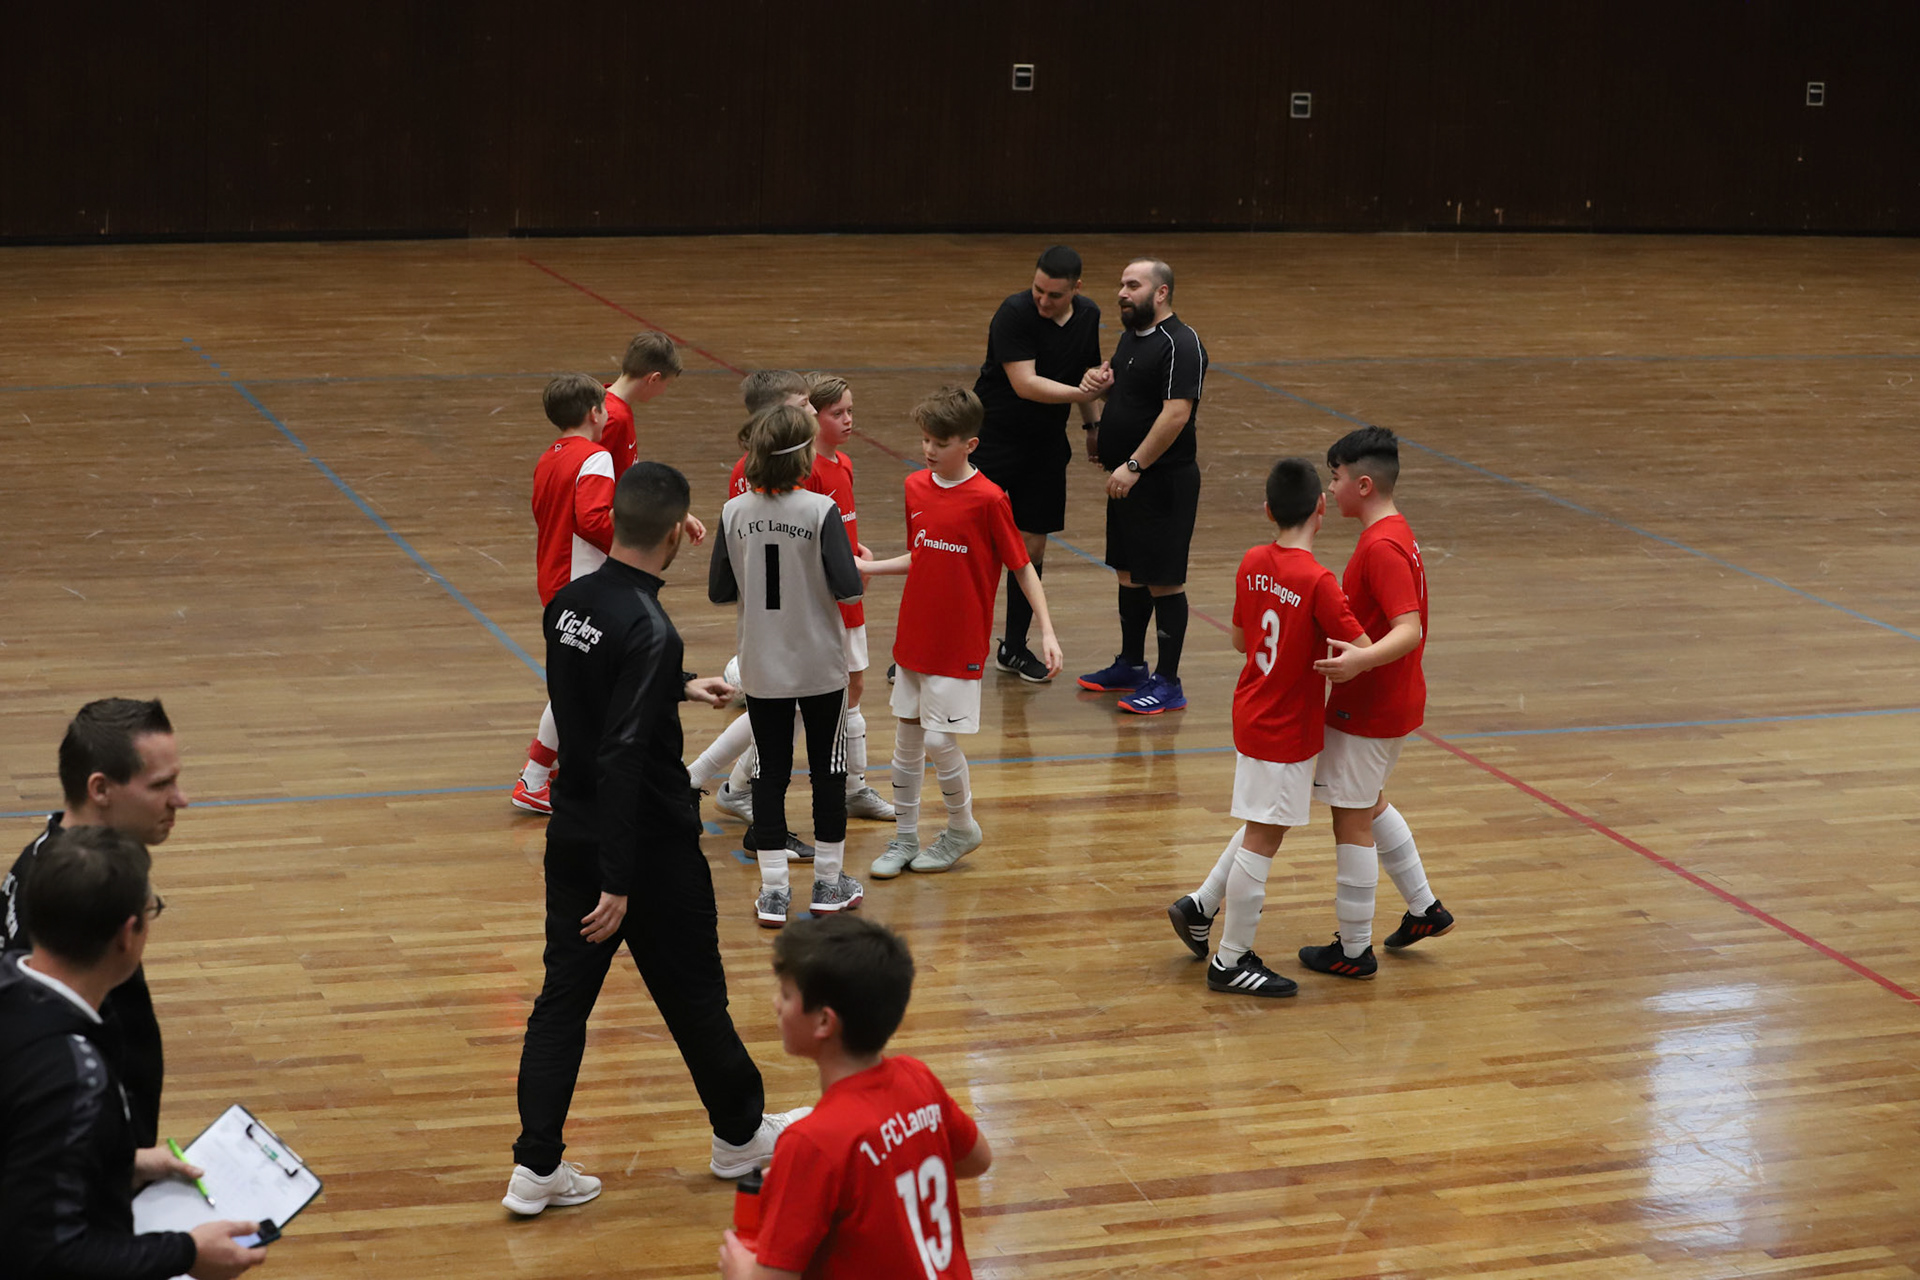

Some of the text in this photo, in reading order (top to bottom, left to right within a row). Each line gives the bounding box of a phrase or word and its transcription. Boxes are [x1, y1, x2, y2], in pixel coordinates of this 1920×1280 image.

[748, 520, 764, 534] FC
[768, 519, 813, 540] Langen
[923, 538, 968, 554] mainova
[764, 543, 781, 610] 1
[1246, 574, 1302, 608] 1. FC Langen
[1255, 608, 1280, 677] 3
[859, 1140, 888, 1167] 1.
[879, 1116, 904, 1153] FC
[895, 1155, 952, 1280] 13
